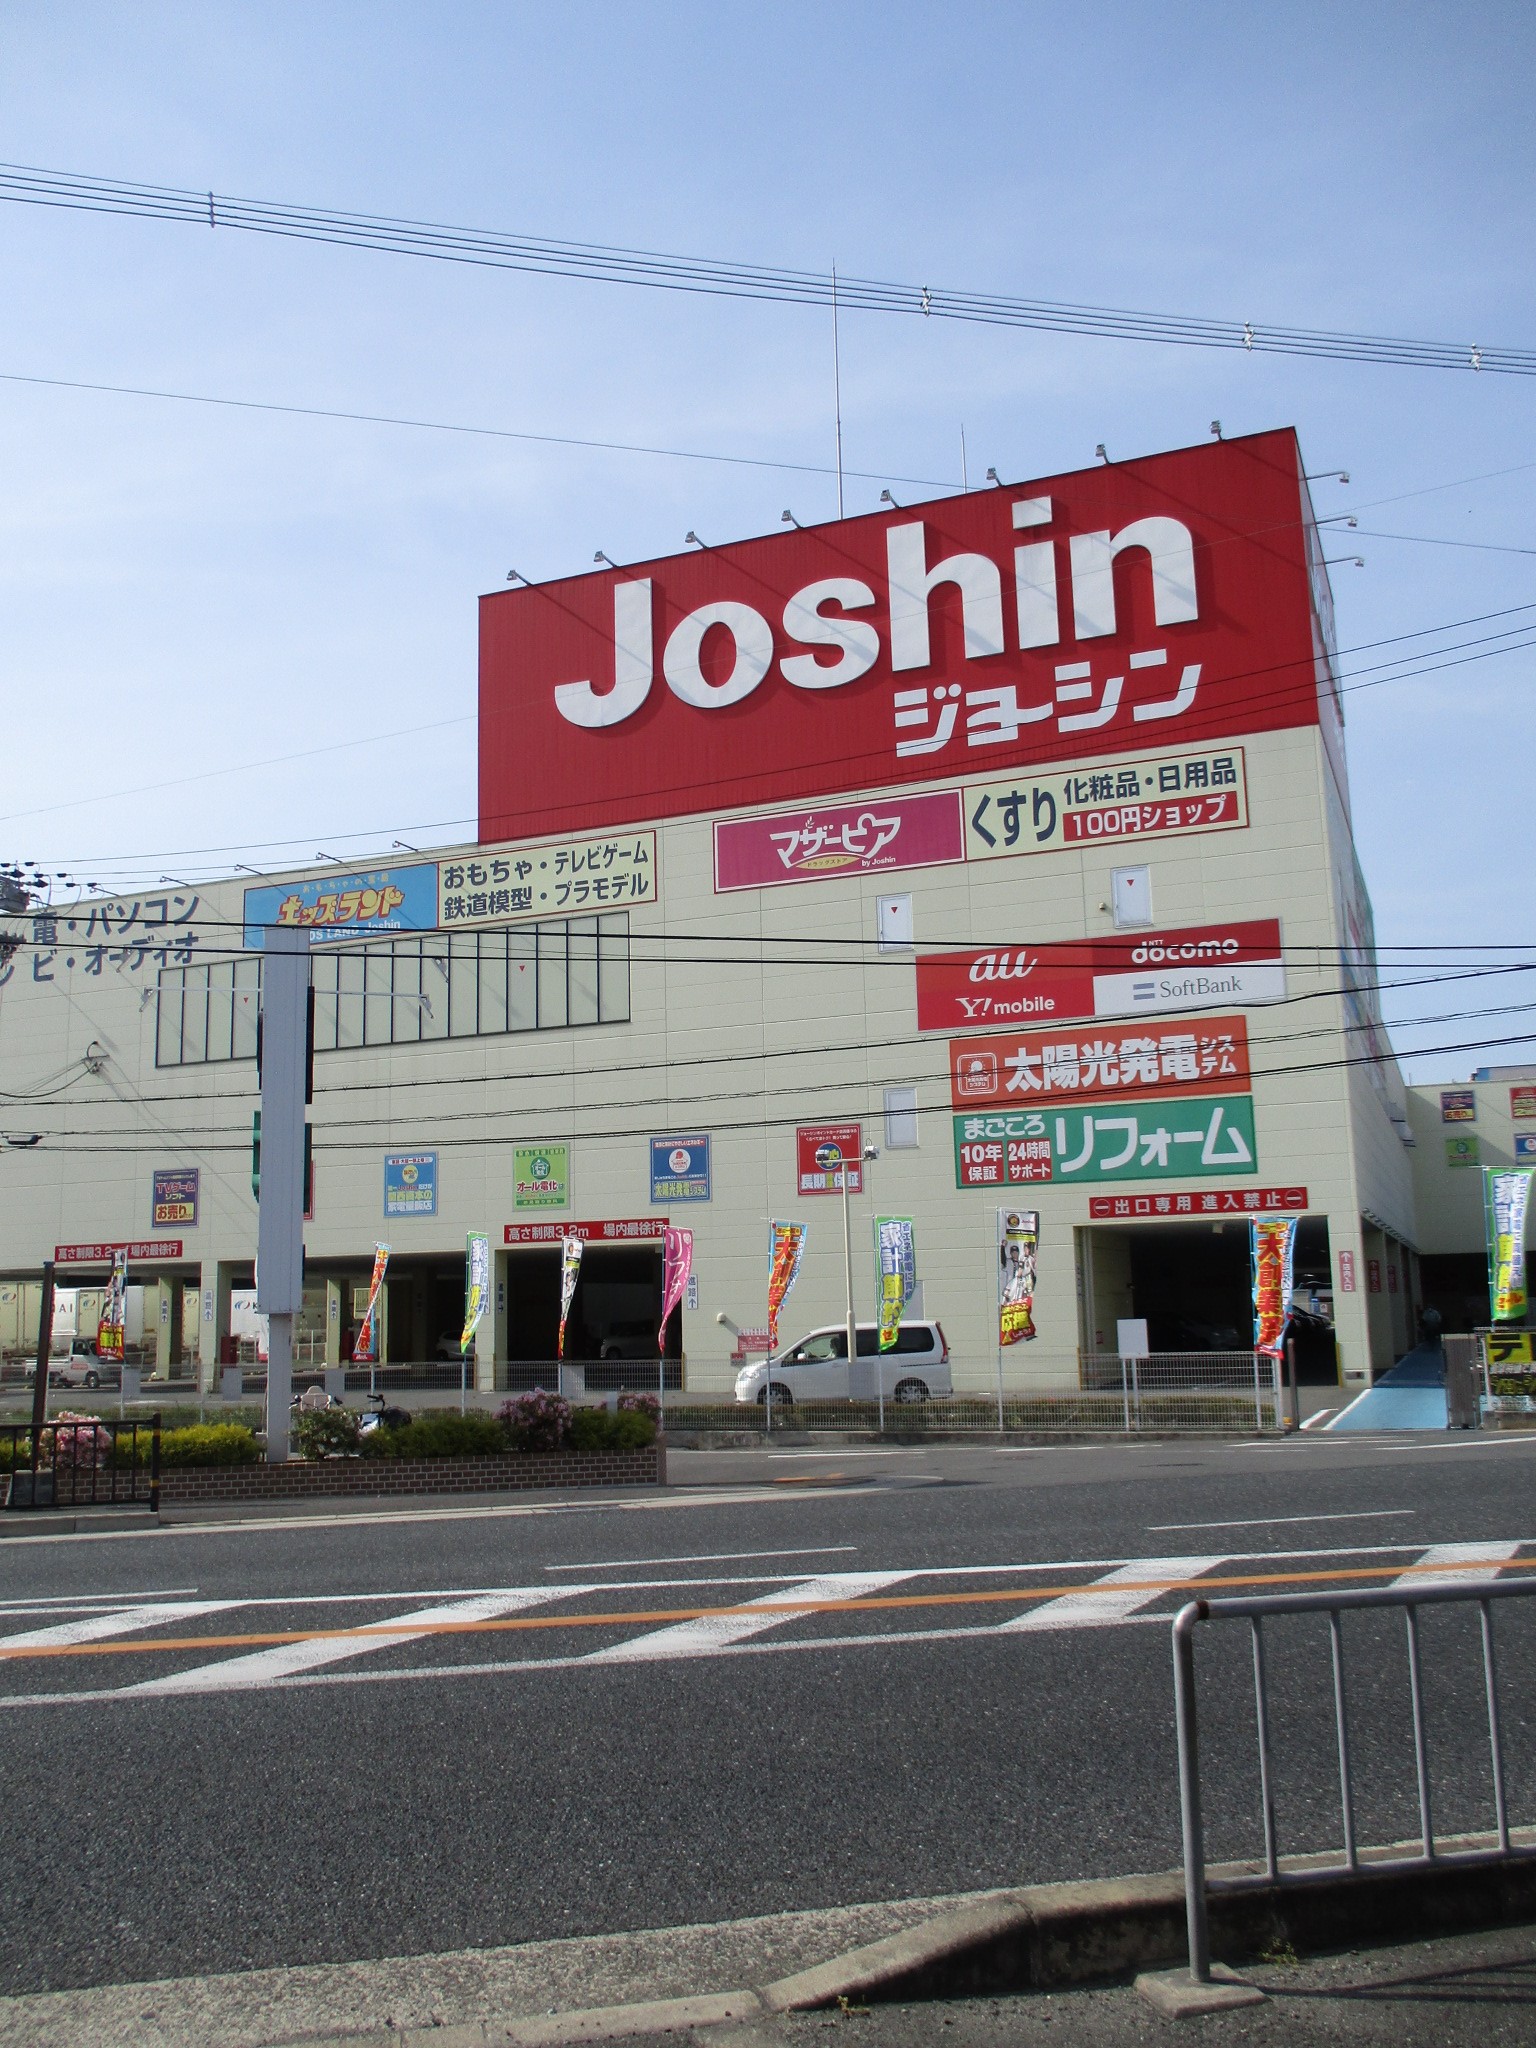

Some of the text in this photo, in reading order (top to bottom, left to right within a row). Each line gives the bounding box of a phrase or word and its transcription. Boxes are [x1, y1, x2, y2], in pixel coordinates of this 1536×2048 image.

[555, 496, 1198, 728] Joshin
[894, 648, 1202, 757] ジョーシン
[1063, 756, 1237, 806] 化粧品・日用品
[971, 787, 1057, 848] くすり
[1072, 794, 1228, 837] 100円ショップ
[769, 812, 901, 869] マザーピア
[444, 840, 649, 889] おもちゃ・テレビゲーム
[861, 856, 896, 867] by Joshin
[276, 885, 405, 926] キッズランド
[444, 873, 649, 921] 鉄道模型・プラモデル
[969, 951, 1037, 982] au
[1131, 938, 1239, 964] docomo
[1159, 975, 1243, 998] SoftBank
[1004, 1034, 1200, 1092] 太陽光発電
[964, 1114, 1046, 1140] まごころ
[1055, 1107, 1252, 1173] リフォーム
[961, 1141, 1051, 1164] 10年 24時間
[968, 1163, 1051, 1181] 保証 サポート
[157, 1182, 196, 1194] TVゲーム
[1115, 1191, 1282, 1214] 出口専用 進入禁止
[58, 1246, 113, 1260] 高さ制限3.2
